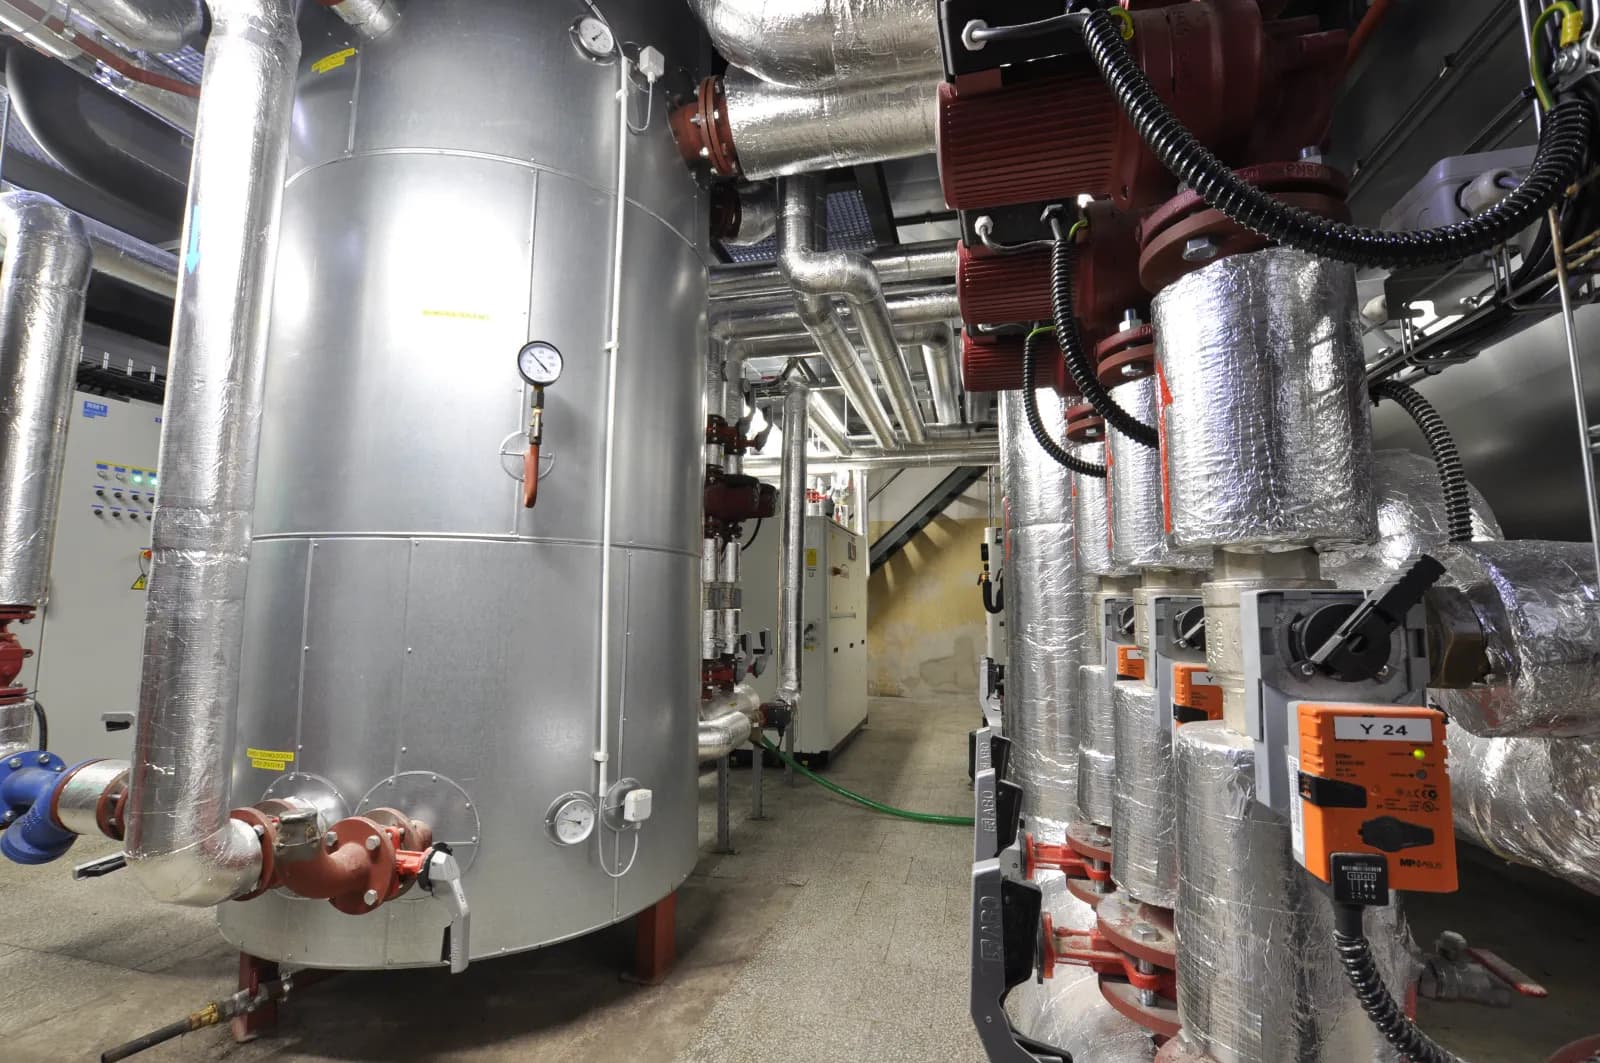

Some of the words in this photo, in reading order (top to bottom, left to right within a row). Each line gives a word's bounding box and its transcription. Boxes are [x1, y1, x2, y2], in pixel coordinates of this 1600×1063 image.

[1360, 724, 1374, 735] Y
[1383, 724, 1408, 736] 24
[979, 895, 1001, 938] ABO
